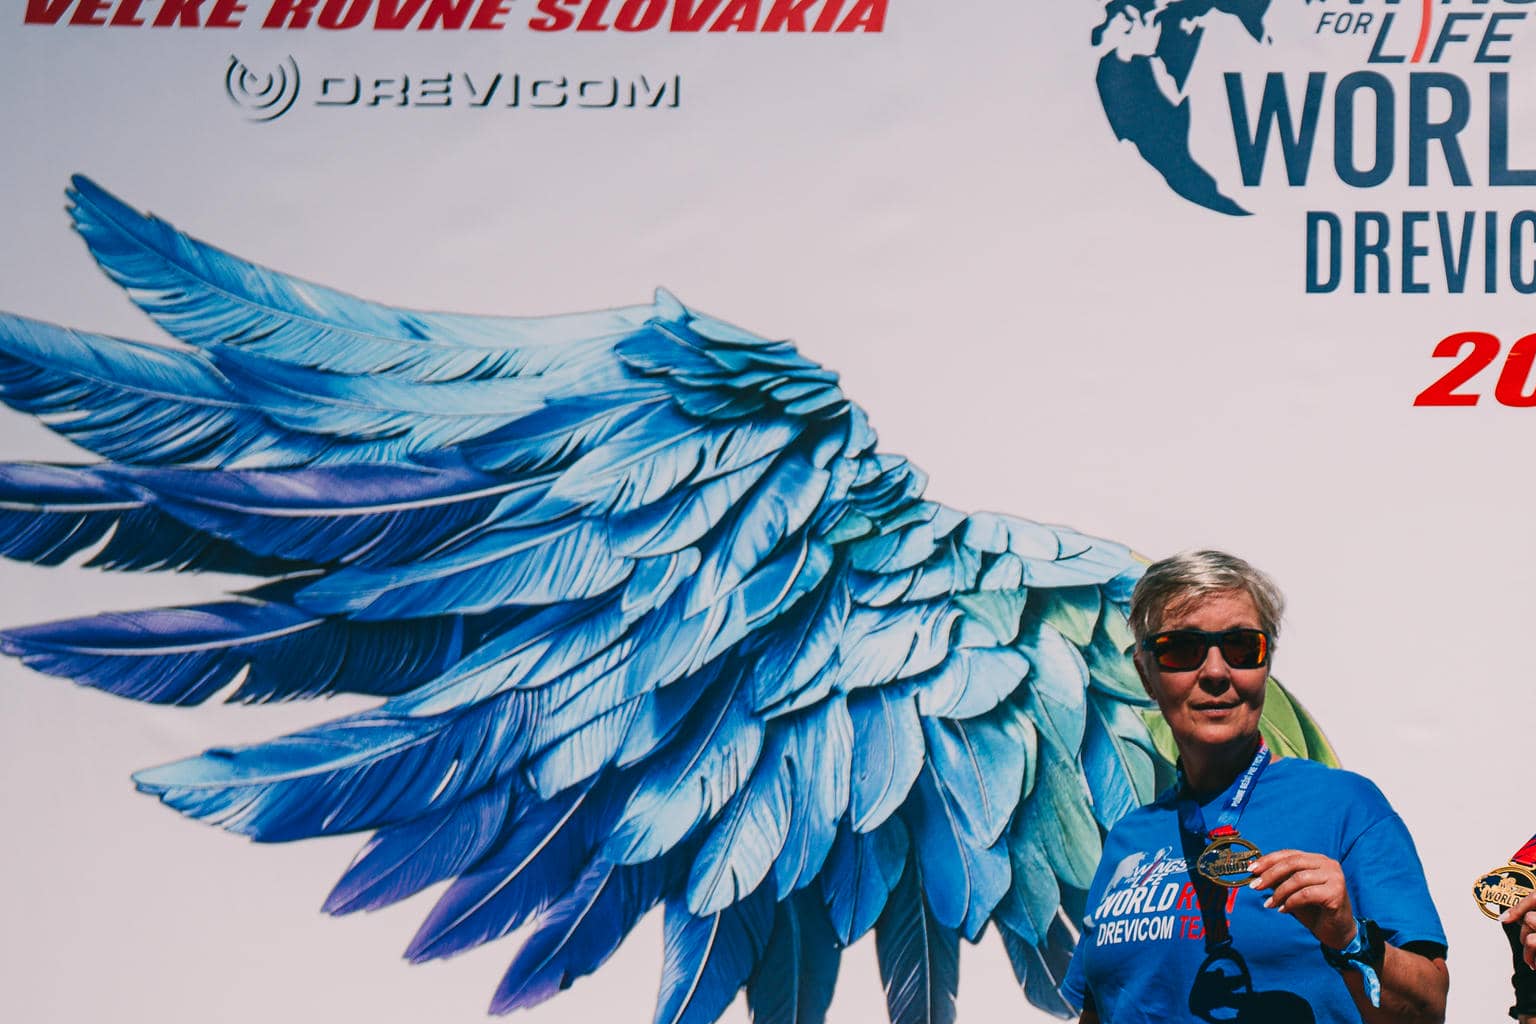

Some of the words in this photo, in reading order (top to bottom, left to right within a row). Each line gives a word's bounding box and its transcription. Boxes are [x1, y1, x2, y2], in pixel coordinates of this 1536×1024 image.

[528, 0, 890, 33] SLOVAKIA
[1316, 12, 1375, 34] FOR
[1367, 11, 1529, 64] LIFE
[314, 73, 681, 109] DREVICOM
[1094, 882, 1180, 920] WORLD
[1176, 881, 1240, 914] RN
[1096, 915, 1175, 947] DREVICOM
